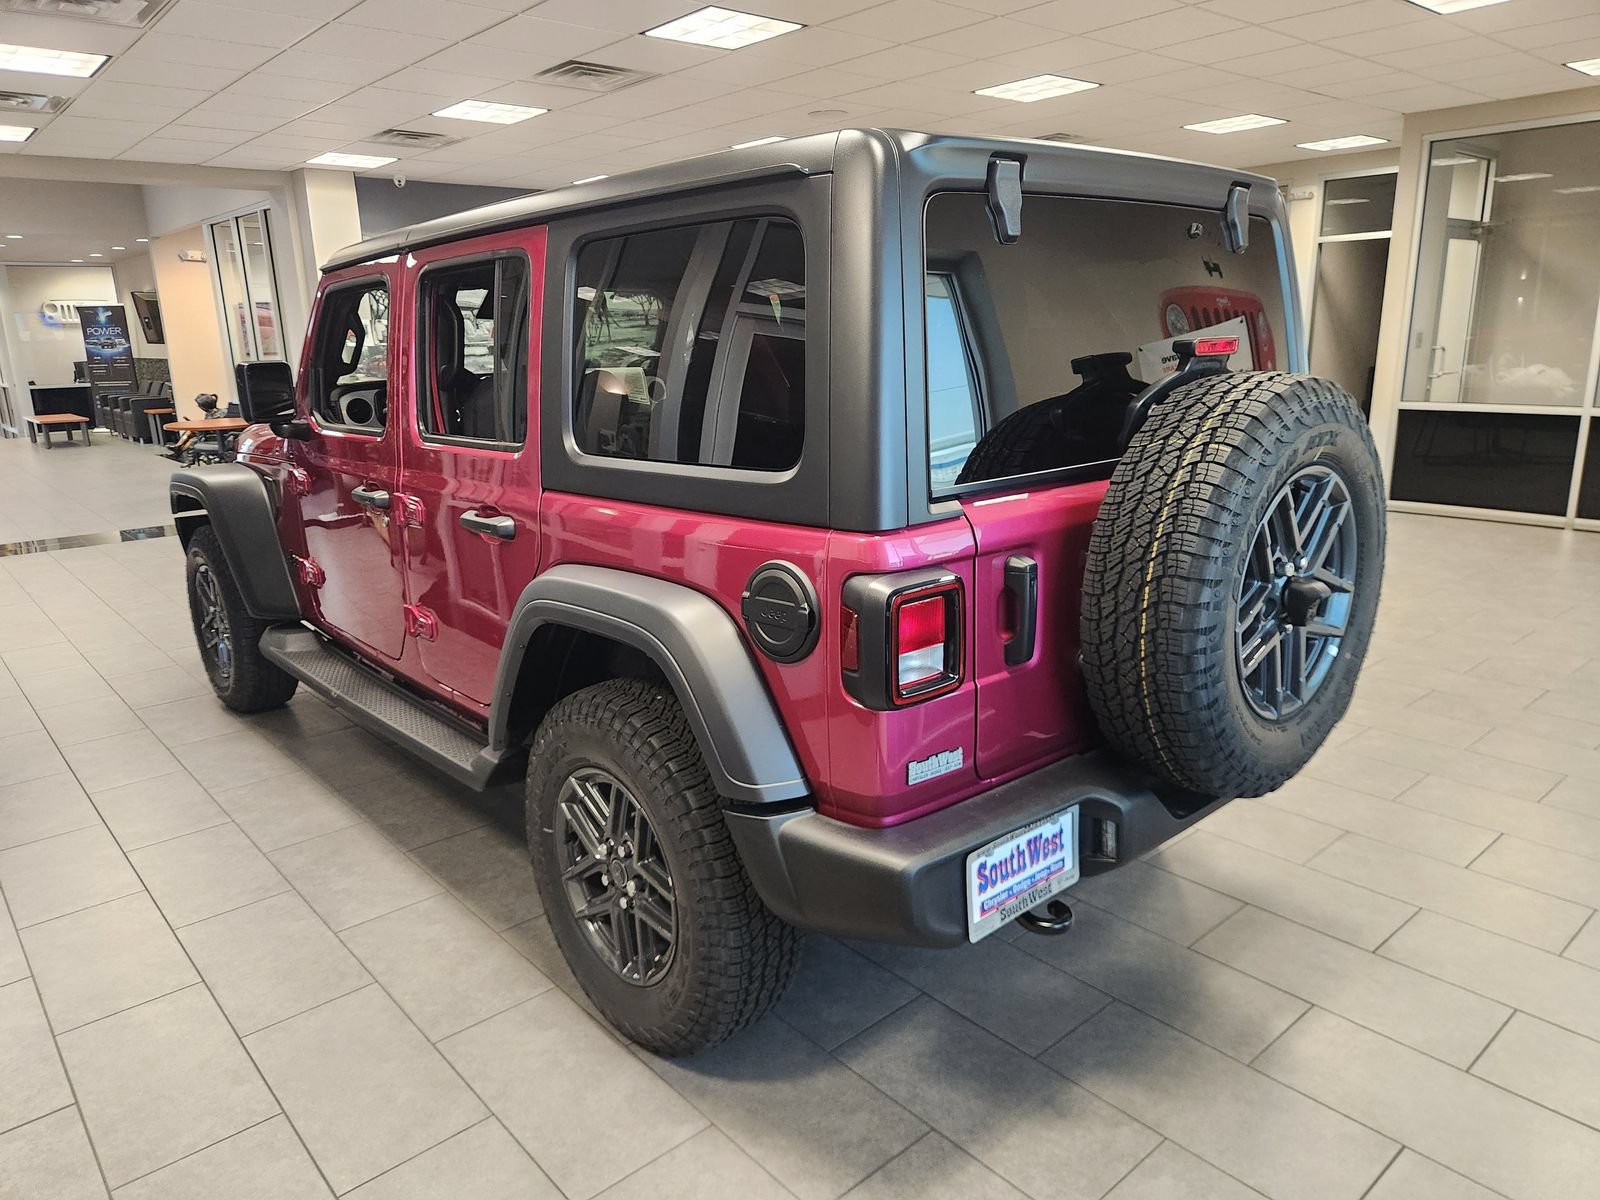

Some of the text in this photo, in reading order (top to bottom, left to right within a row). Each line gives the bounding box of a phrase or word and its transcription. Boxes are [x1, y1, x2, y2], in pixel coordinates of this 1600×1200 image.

[87, 327, 122, 335] POWER
[761, 610, 788, 624] Jeep
[977, 823, 1064, 896] SouthWest
[1000, 884, 1053, 921] SouthWest
